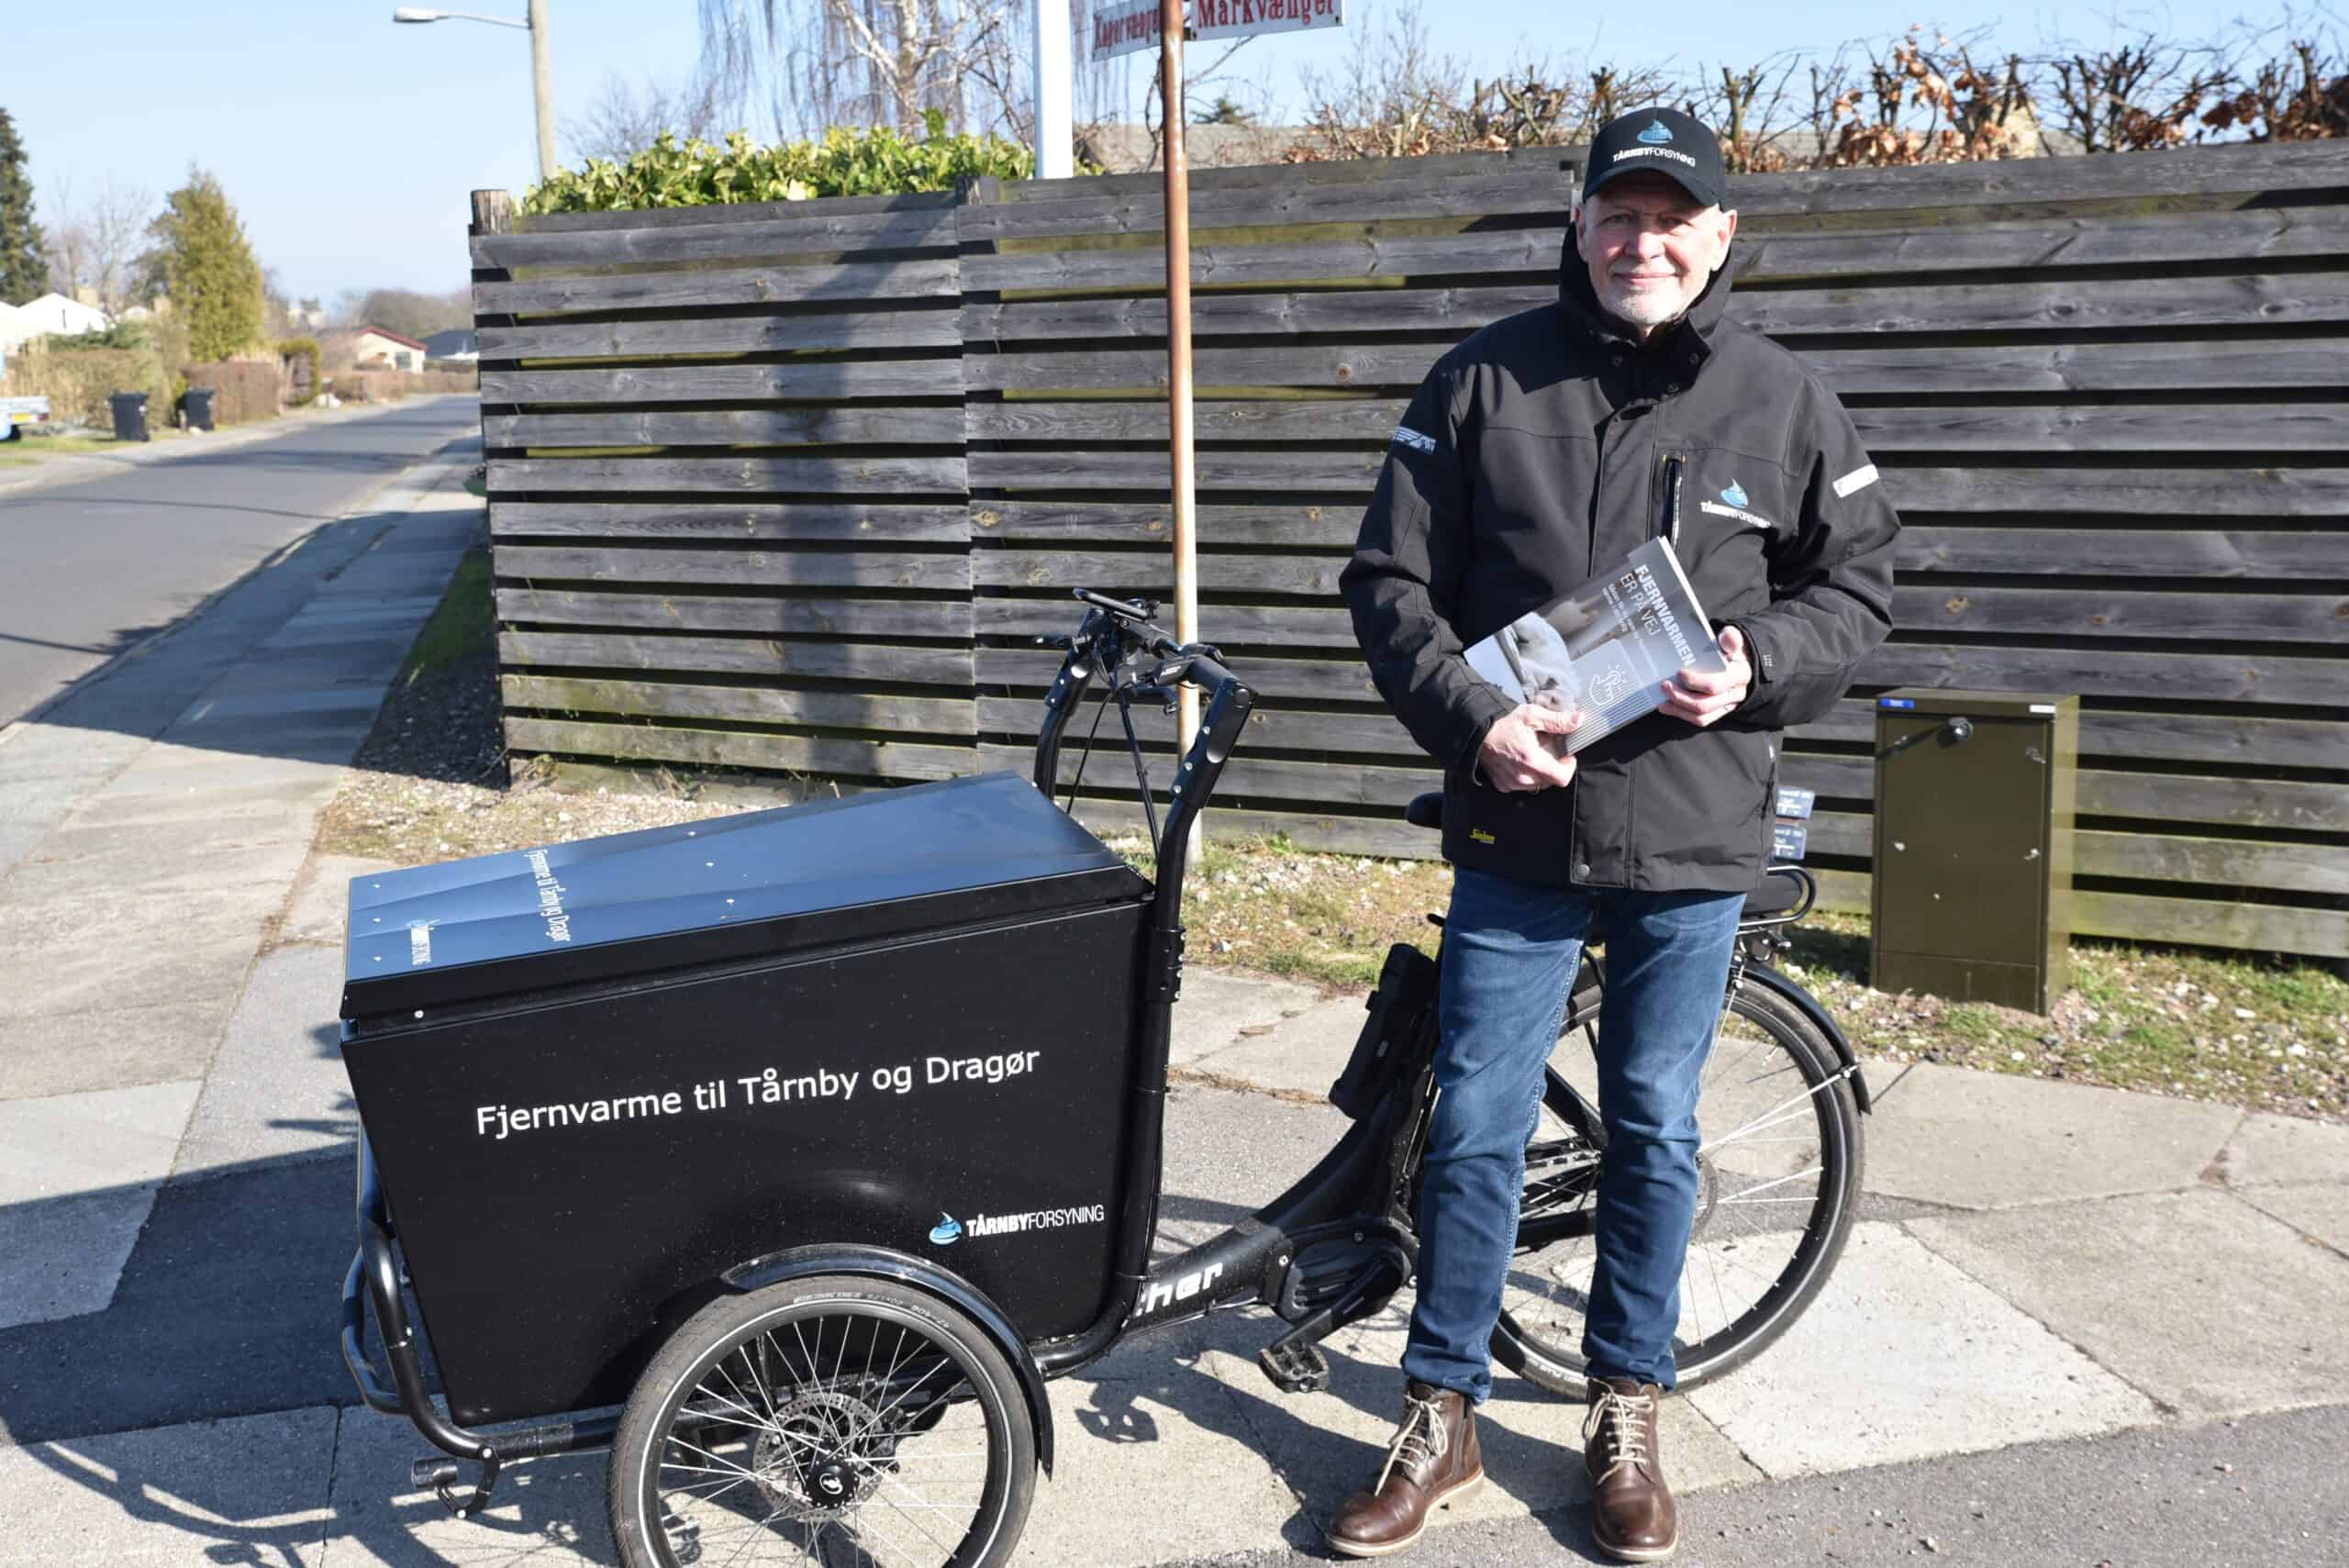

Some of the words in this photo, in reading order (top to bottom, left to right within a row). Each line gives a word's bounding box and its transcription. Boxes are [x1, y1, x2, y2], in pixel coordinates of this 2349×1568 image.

[1620, 573, 1638, 594] ER
[1641, 608, 1661, 636] VEJ
[1635, 564, 1696, 666] FJERNVARMEN
[476, 1089, 683, 1140] Fjernvarme
[694, 1079, 727, 1111] til
[737, 1067, 860, 1106] Tårnby
[872, 1065, 912, 1095] og
[925, 1051, 1041, 1084] Dragør
[966, 1204, 1105, 1238] TÅRNBYFORSYNING
[1137, 1262, 1223, 1317] her
